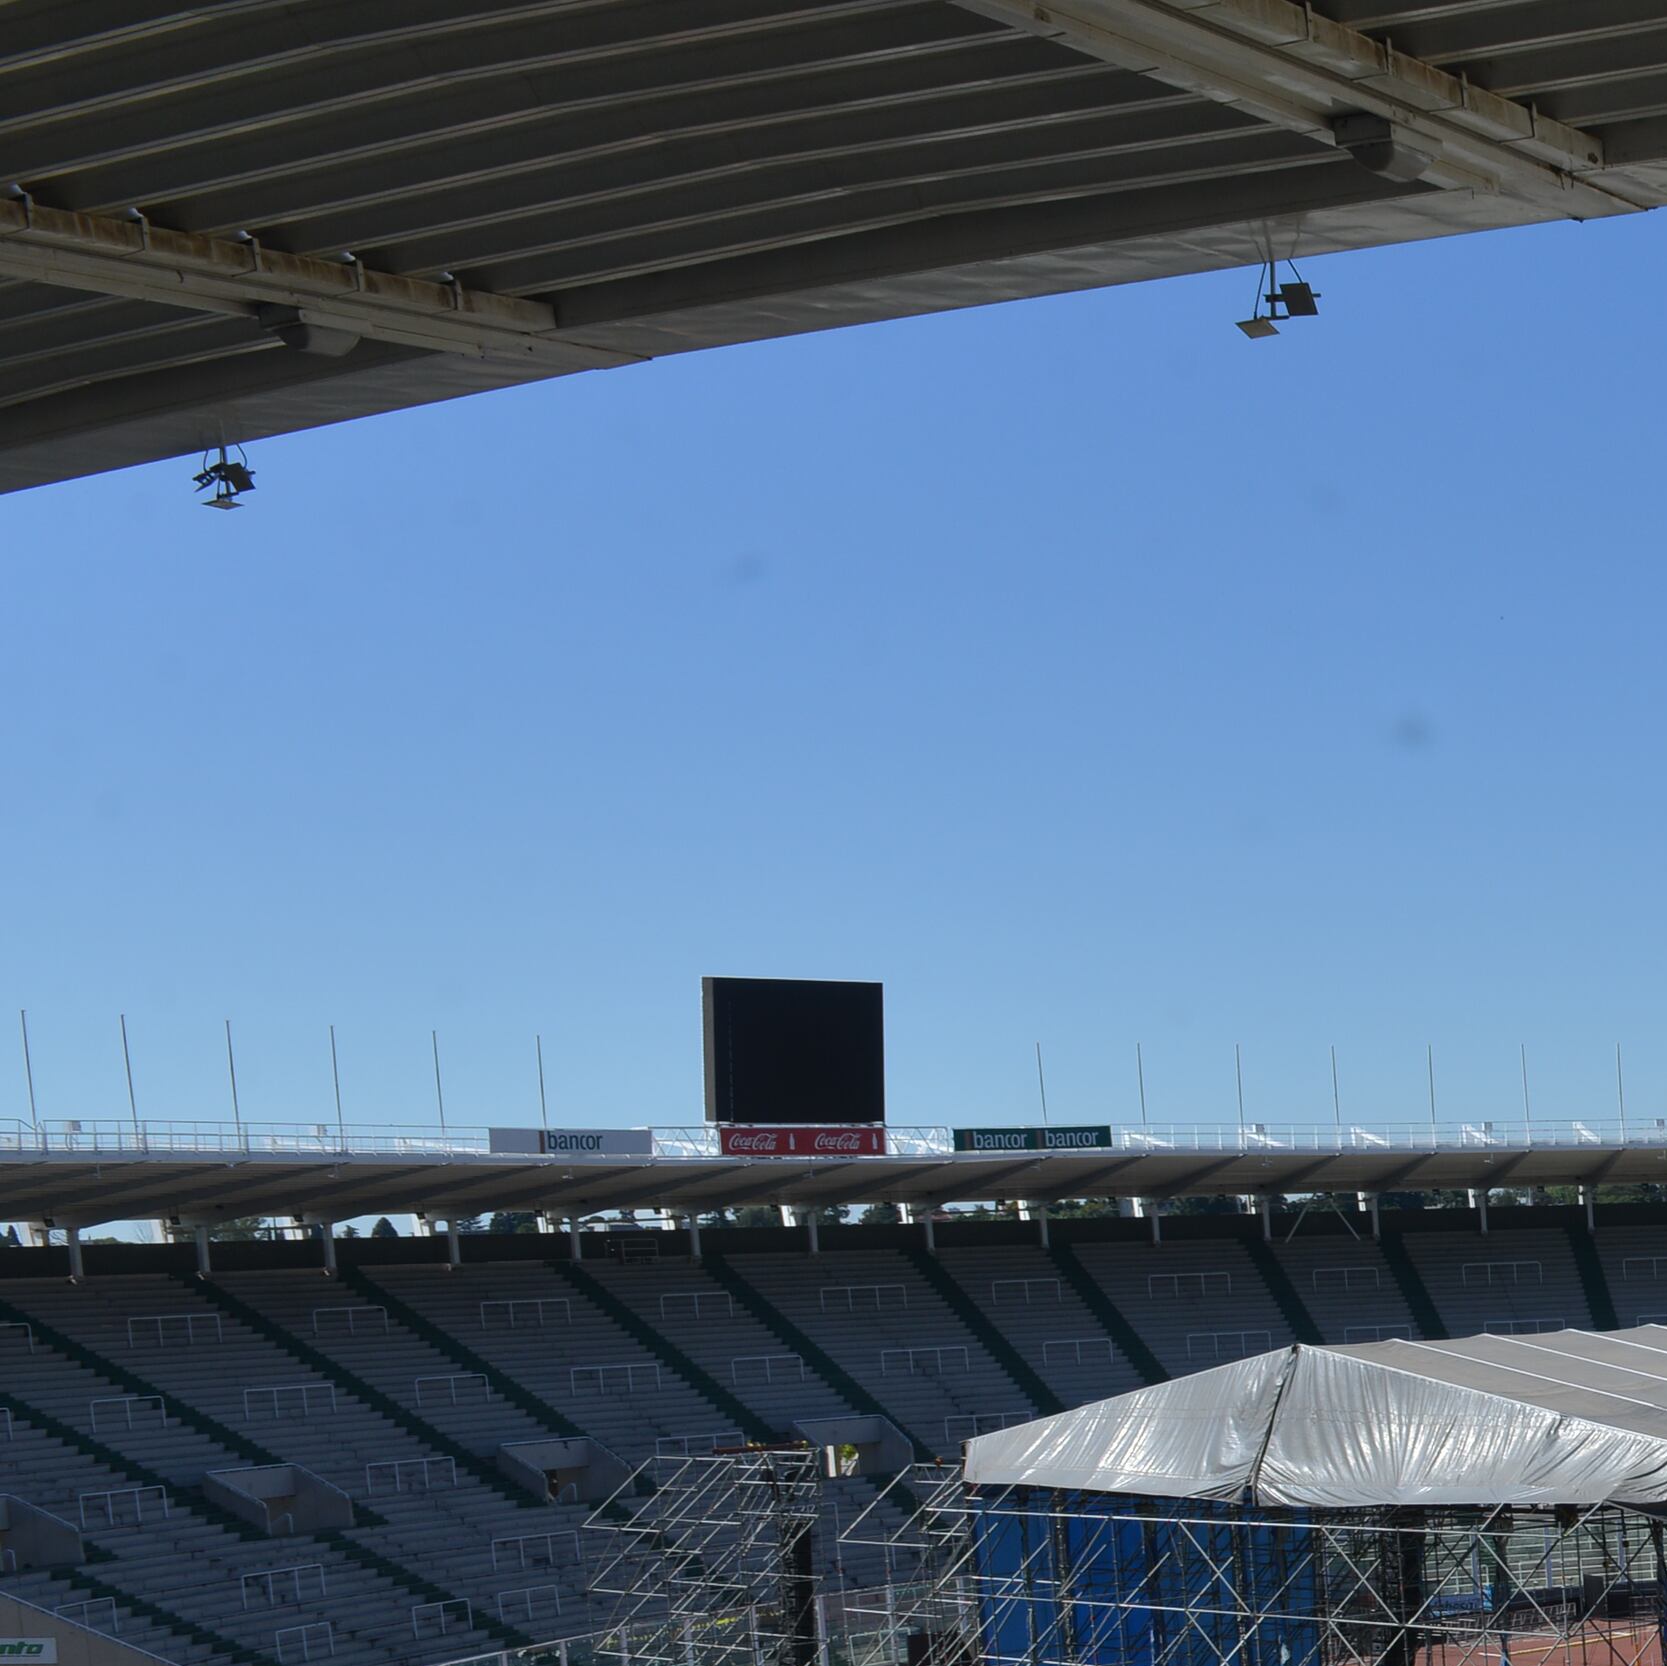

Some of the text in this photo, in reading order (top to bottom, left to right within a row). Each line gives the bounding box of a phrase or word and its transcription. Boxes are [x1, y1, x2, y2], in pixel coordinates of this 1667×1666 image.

[547, 1131, 603, 1151] bancor
[729, 1133, 777, 1151] Coca-Cola
[814, 1131, 861, 1150] Coca-Cola
[973, 1131, 1028, 1149] bancor
[1045, 1130, 1099, 1147] bancor
